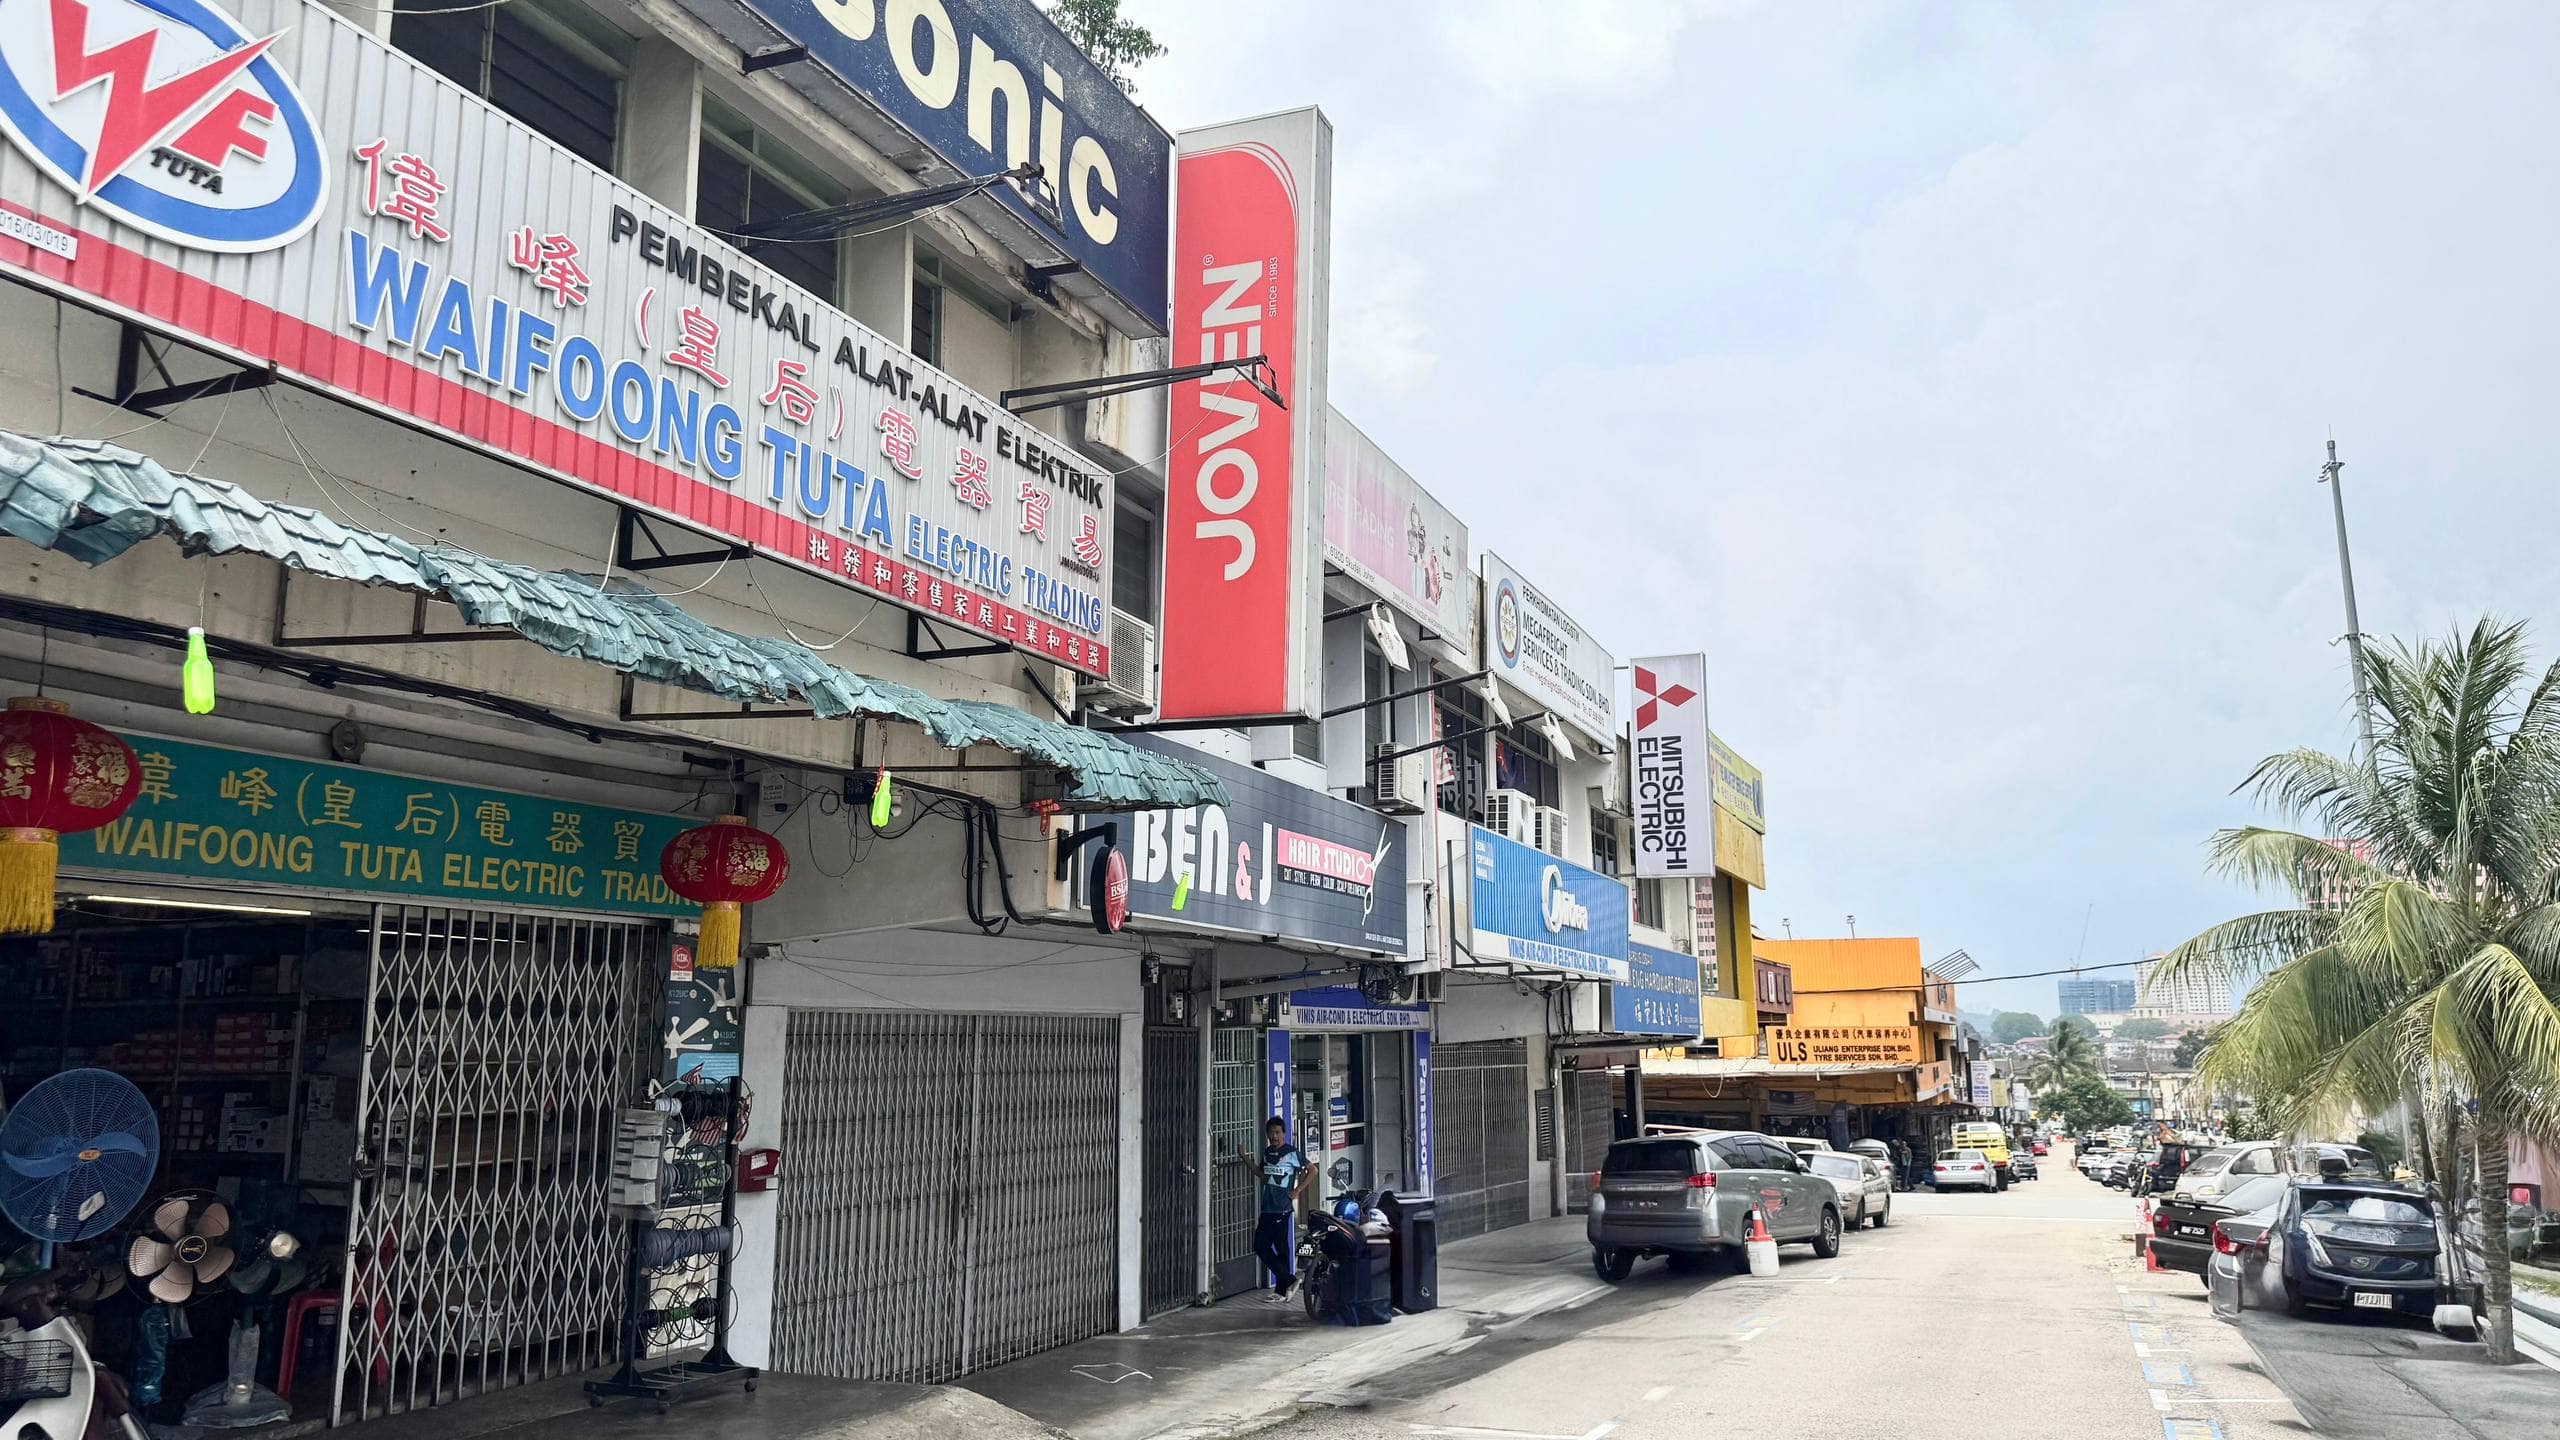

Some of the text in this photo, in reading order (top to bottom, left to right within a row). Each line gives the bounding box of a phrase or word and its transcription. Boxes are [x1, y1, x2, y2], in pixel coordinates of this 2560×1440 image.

[151, 146, 225, 195] TUTA
[1267, 255, 1279, 318] since 1983
[611, 203, 1104, 510] PEMBEKAL ALAT-ALAT ELEKTRIK
[344, 226, 1102, 636] WAIFOONG TUTA ELECTRIC TRADING
[1195, 259, 1264, 582] JOVEN
[1351, 496, 1395, 549] TRADING
[808, 532, 1099, 668] 批發和零售家庭工業和電器
[1522, 585, 1560, 626] PERKHIDMATAN
[1560, 617, 1580, 644] LOGISTIK
[1522, 611, 1568, 661] MEGAFREIGHT
[1522, 635, 1554, 673] SERVICES
[1554, 658, 1559, 676] &
[1560, 662, 1585, 697] TRADING
[1637, 736, 1663, 853] ELECTRIC
[1661, 735, 1688, 870] MITSUBISHI
[94, 816, 314, 874] WAIFOONG
[339, 840, 424, 884] TUTA
[442, 852, 585, 898] ELECTRIC
[1235, 840, 1253, 901] &
[1259, 821, 1273, 905] J
[1288, 837, 1368, 881] HAIR STUDIO
[1644, 971, 1675, 994] HARDWARE
[1674, 975, 1697, 997] COMPANY
[1296, 1007, 1315, 1025] VINIS
[1316, 1008, 1346, 1025] AIR-COND
[1352, 1009, 1386, 1026] ELECTRICAL
[1776, 1041, 1808, 1062] ULS
[1813, 1045, 1912, 1053] ULIANG ENTERPRISE SDN. BHD.
[1814, 1053, 1899, 1062] TYRE SERVICES SDN. BHD.
